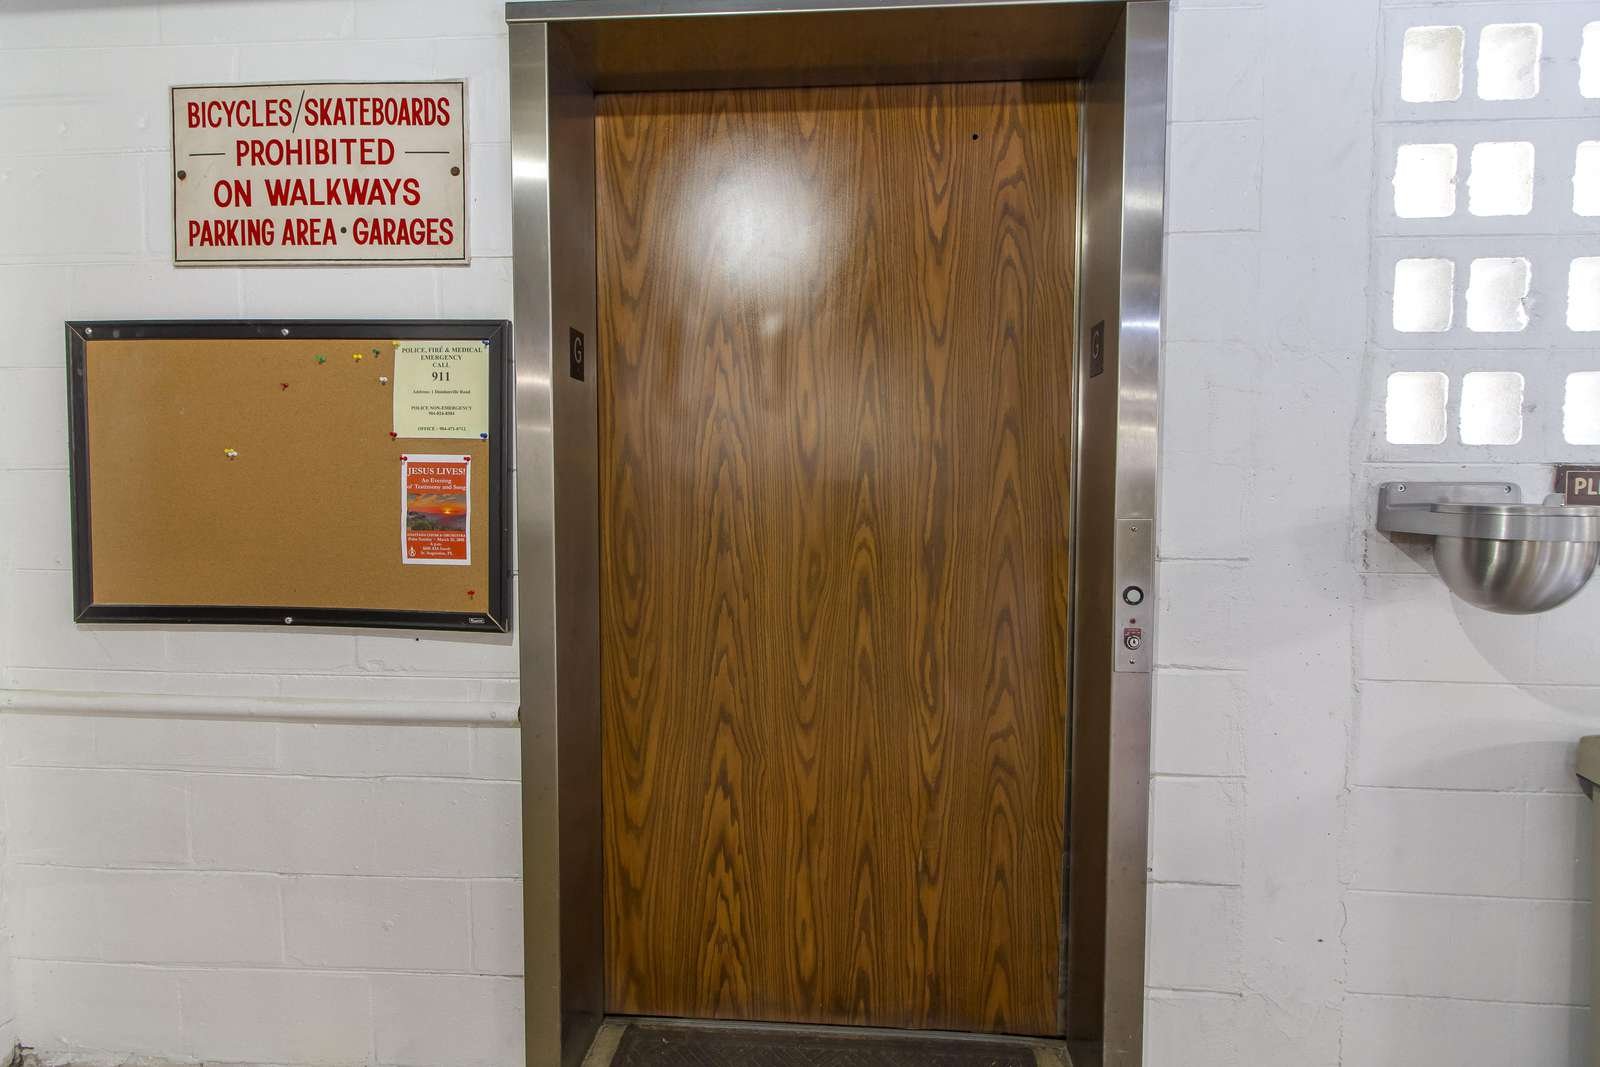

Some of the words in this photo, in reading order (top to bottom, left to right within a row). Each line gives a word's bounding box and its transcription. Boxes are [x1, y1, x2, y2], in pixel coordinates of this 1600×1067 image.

[236, 138, 395, 166] PROHIBITED
[213, 179, 251, 208] ON
[264, 178, 421, 207] WALKWAYS
[188, 218, 275, 247] PARKING
[281, 218, 337, 246] AREA
[352, 217, 454, 246] GARAGES
[574, 336, 582, 364] G
[432, 371, 450, 381] 911
[407, 467, 435, 476] JESUS
[437, 467, 466, 475] LIVES!
[430, 477, 452, 485] Evening
[1575, 477, 1600, 495] PL
